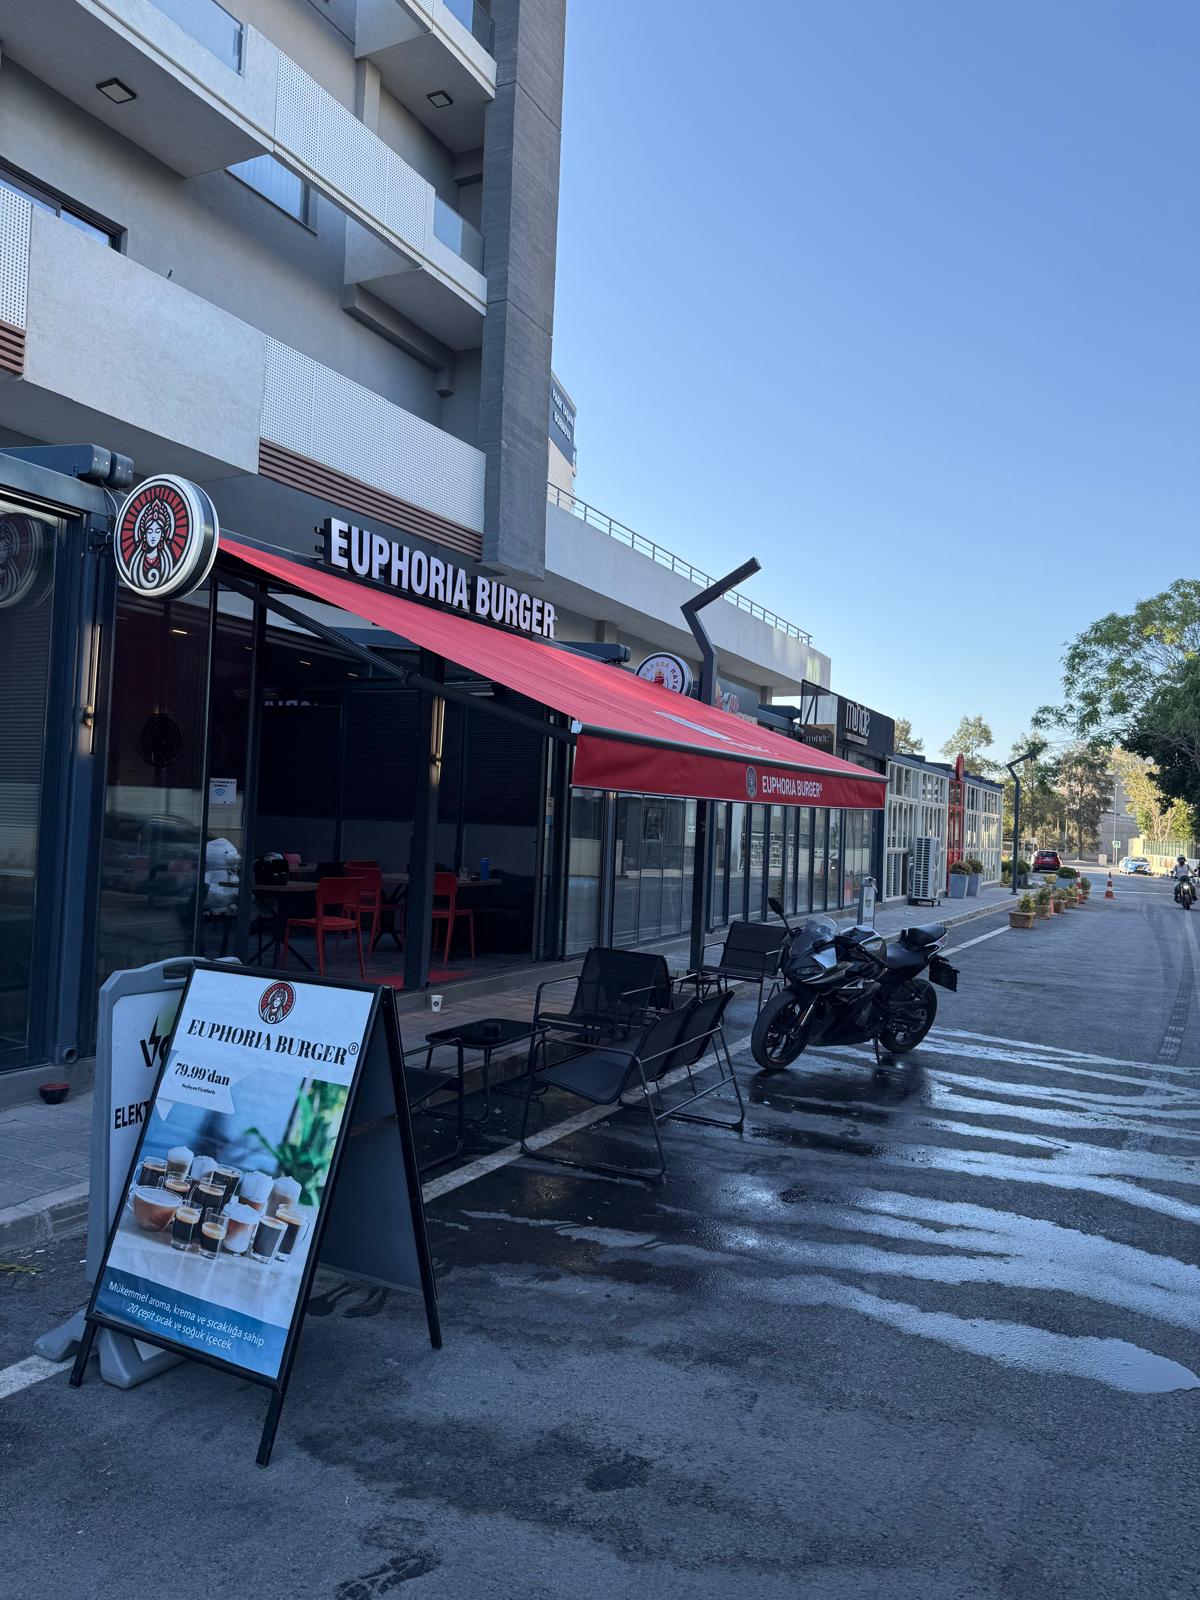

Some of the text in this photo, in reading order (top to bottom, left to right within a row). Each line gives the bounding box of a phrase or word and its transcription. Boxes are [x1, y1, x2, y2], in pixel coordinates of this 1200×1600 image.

[330, 517, 556, 639] EUPHORIA BURGER
[762, 775, 797, 796] EUPHORIA
[187, 1019, 272, 1051] EUPHORIA
[108, 1280, 265, 1349] Mükemmel aroma, krema ve sıcaklığa sahip
[126, 1302, 233, 1351] 20 çeşit sıcak ve soğuk içecek
